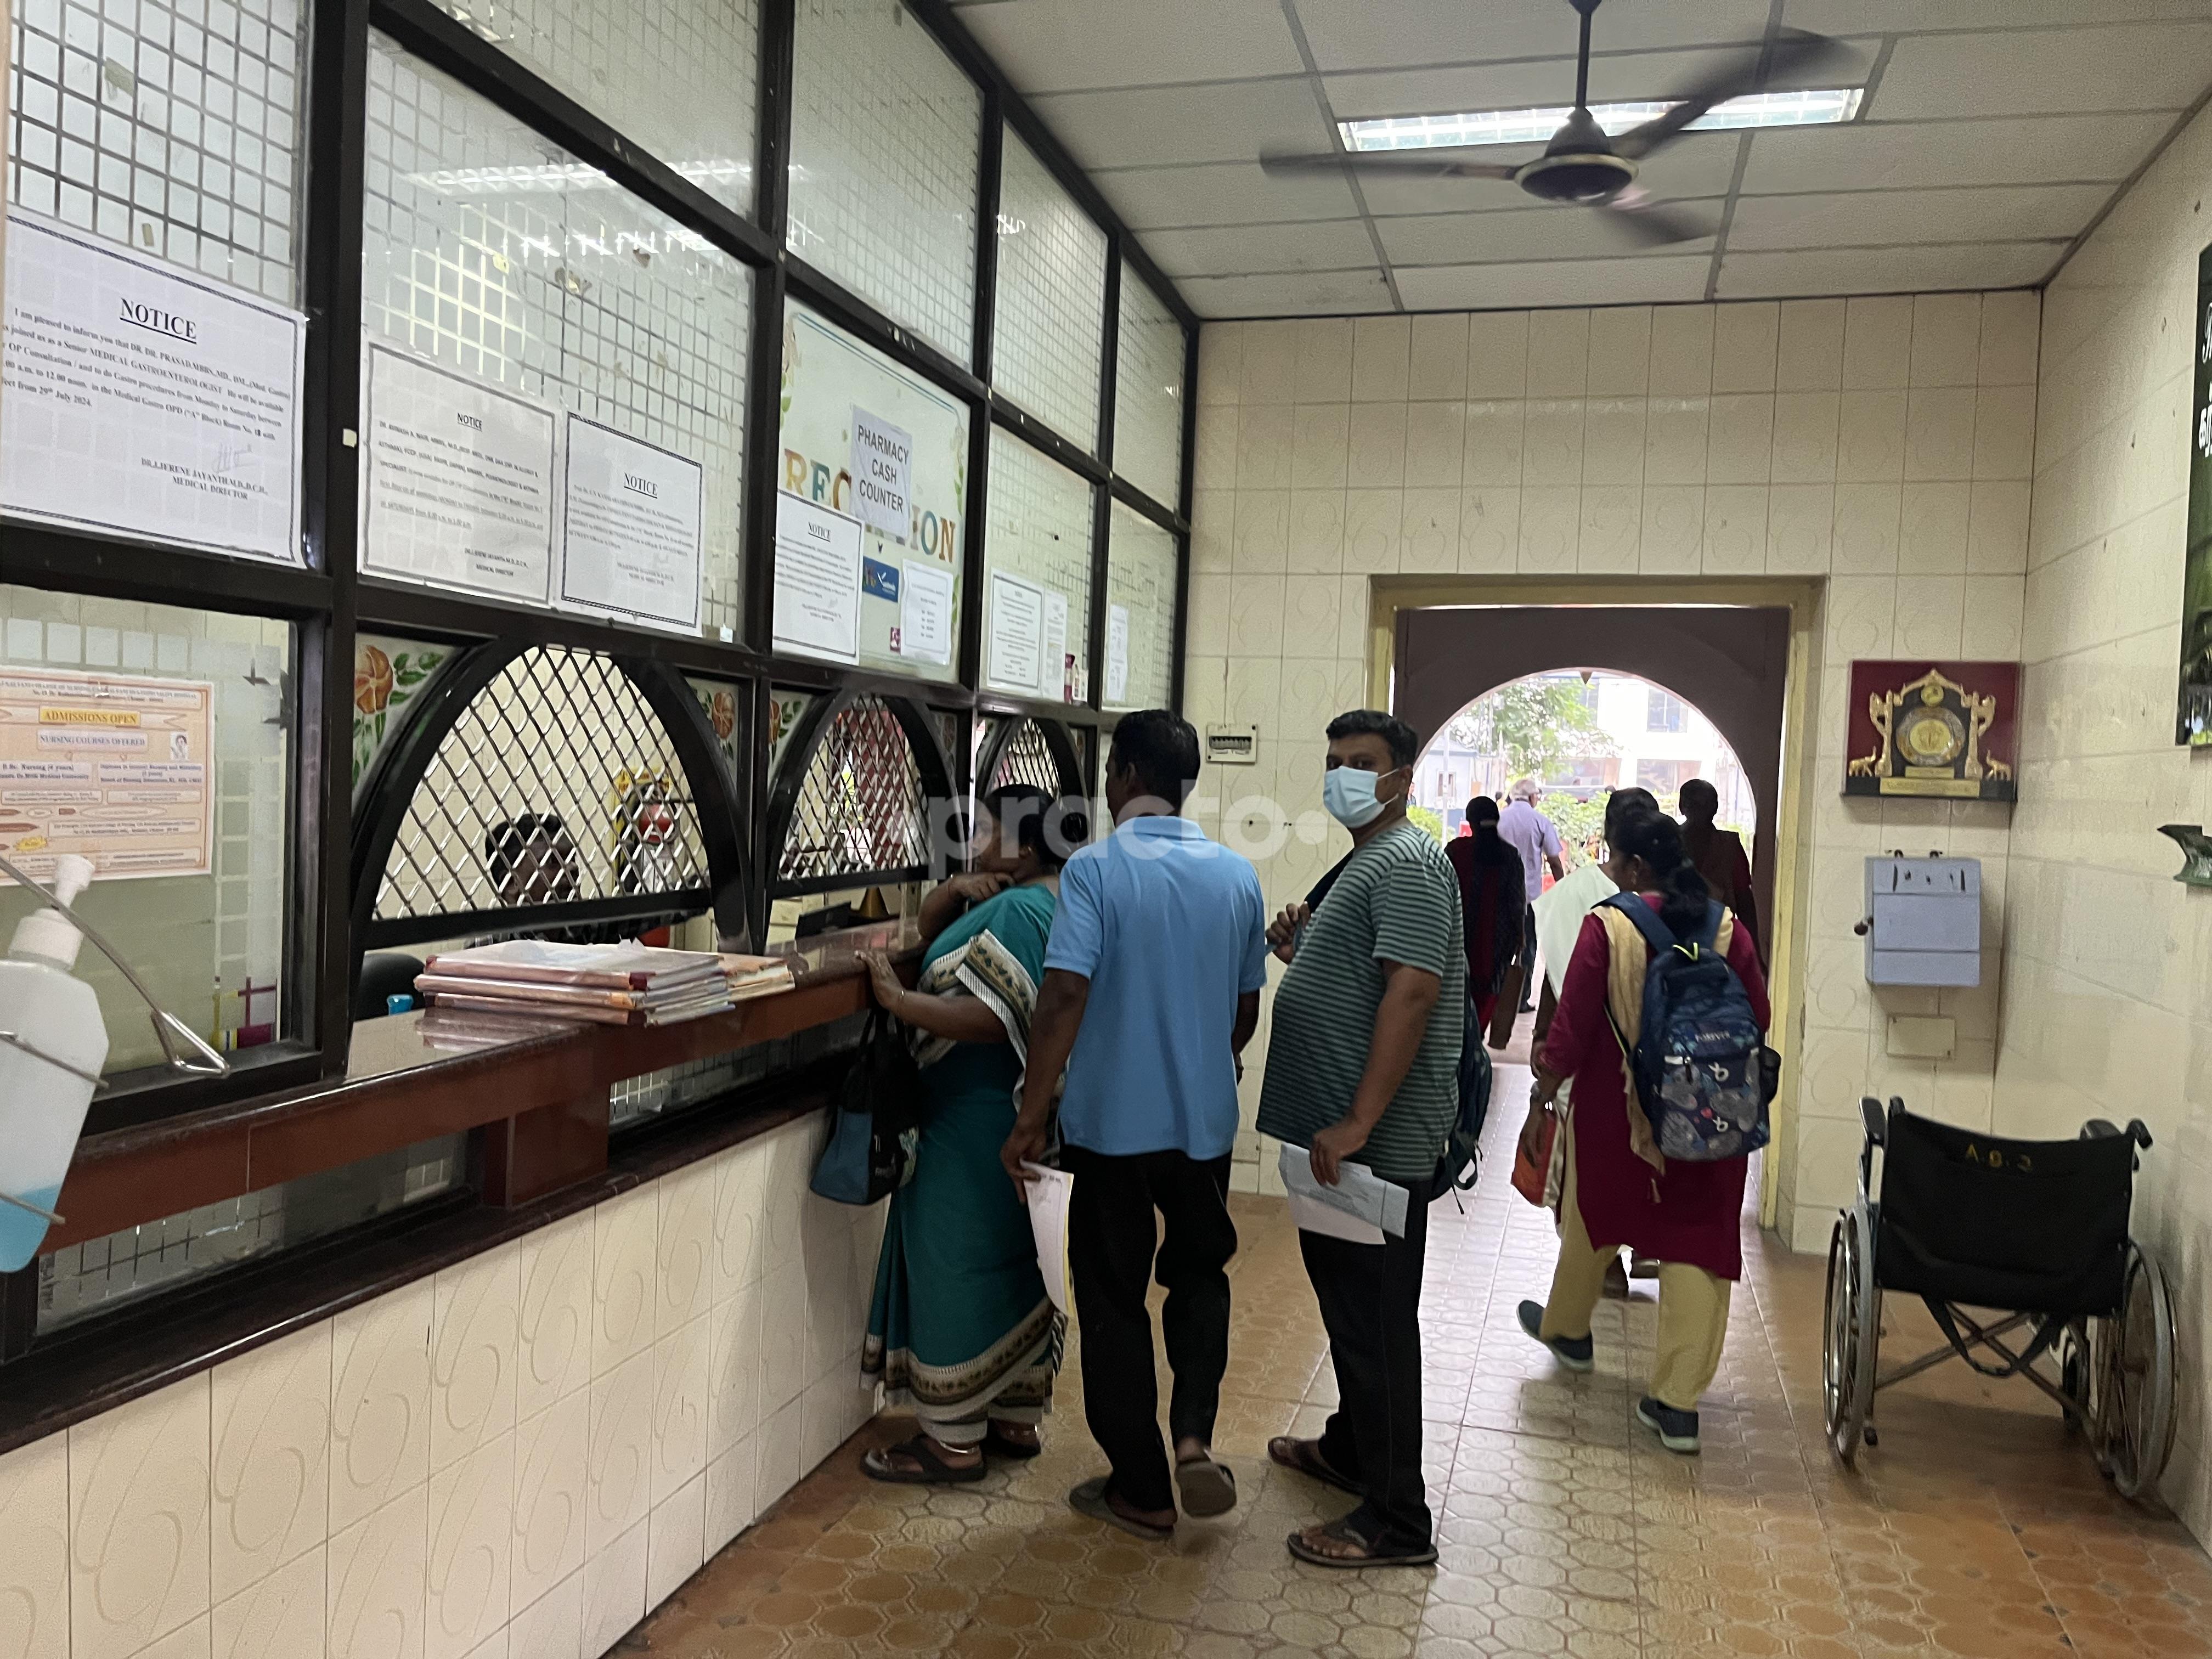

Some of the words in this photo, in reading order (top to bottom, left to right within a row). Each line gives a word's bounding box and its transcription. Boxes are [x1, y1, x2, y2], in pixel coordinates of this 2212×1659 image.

[120, 298, 196, 338] NOTICE
[34, 315, 61, 329] pleased
[72, 325, 98, 340] inform
[115, 339, 128, 349] that
[9, 342, 21, 352] OP
[24, 347, 71, 366] Consultation
[78, 364, 92, 372] and
[90, 347, 128, 365] MEDICAL
[18, 381, 37, 393] from
[100, 386, 111, 395] the
[114, 388, 140, 403] Medical
[166, 404, 183, 414] OPD
[457, 413, 483, 430] NOTICE
[858, 425, 909, 466] PHARMACY
[624, 472, 658, 496] NOTICE
[872, 459, 897, 486] CASH
[173, 476, 207, 491] MEDICAL
[210, 485, 248, 500] DIRECTOR
[859, 479, 904, 514] COUNTER
[808, 522, 831, 539] NOTICE
[46, 710, 108, 723] ADMISSIONS
[110, 714, 136, 724] OPEN
[40, 735, 74, 743] NURSING
[111, 738, 145, 746] OFFERED
